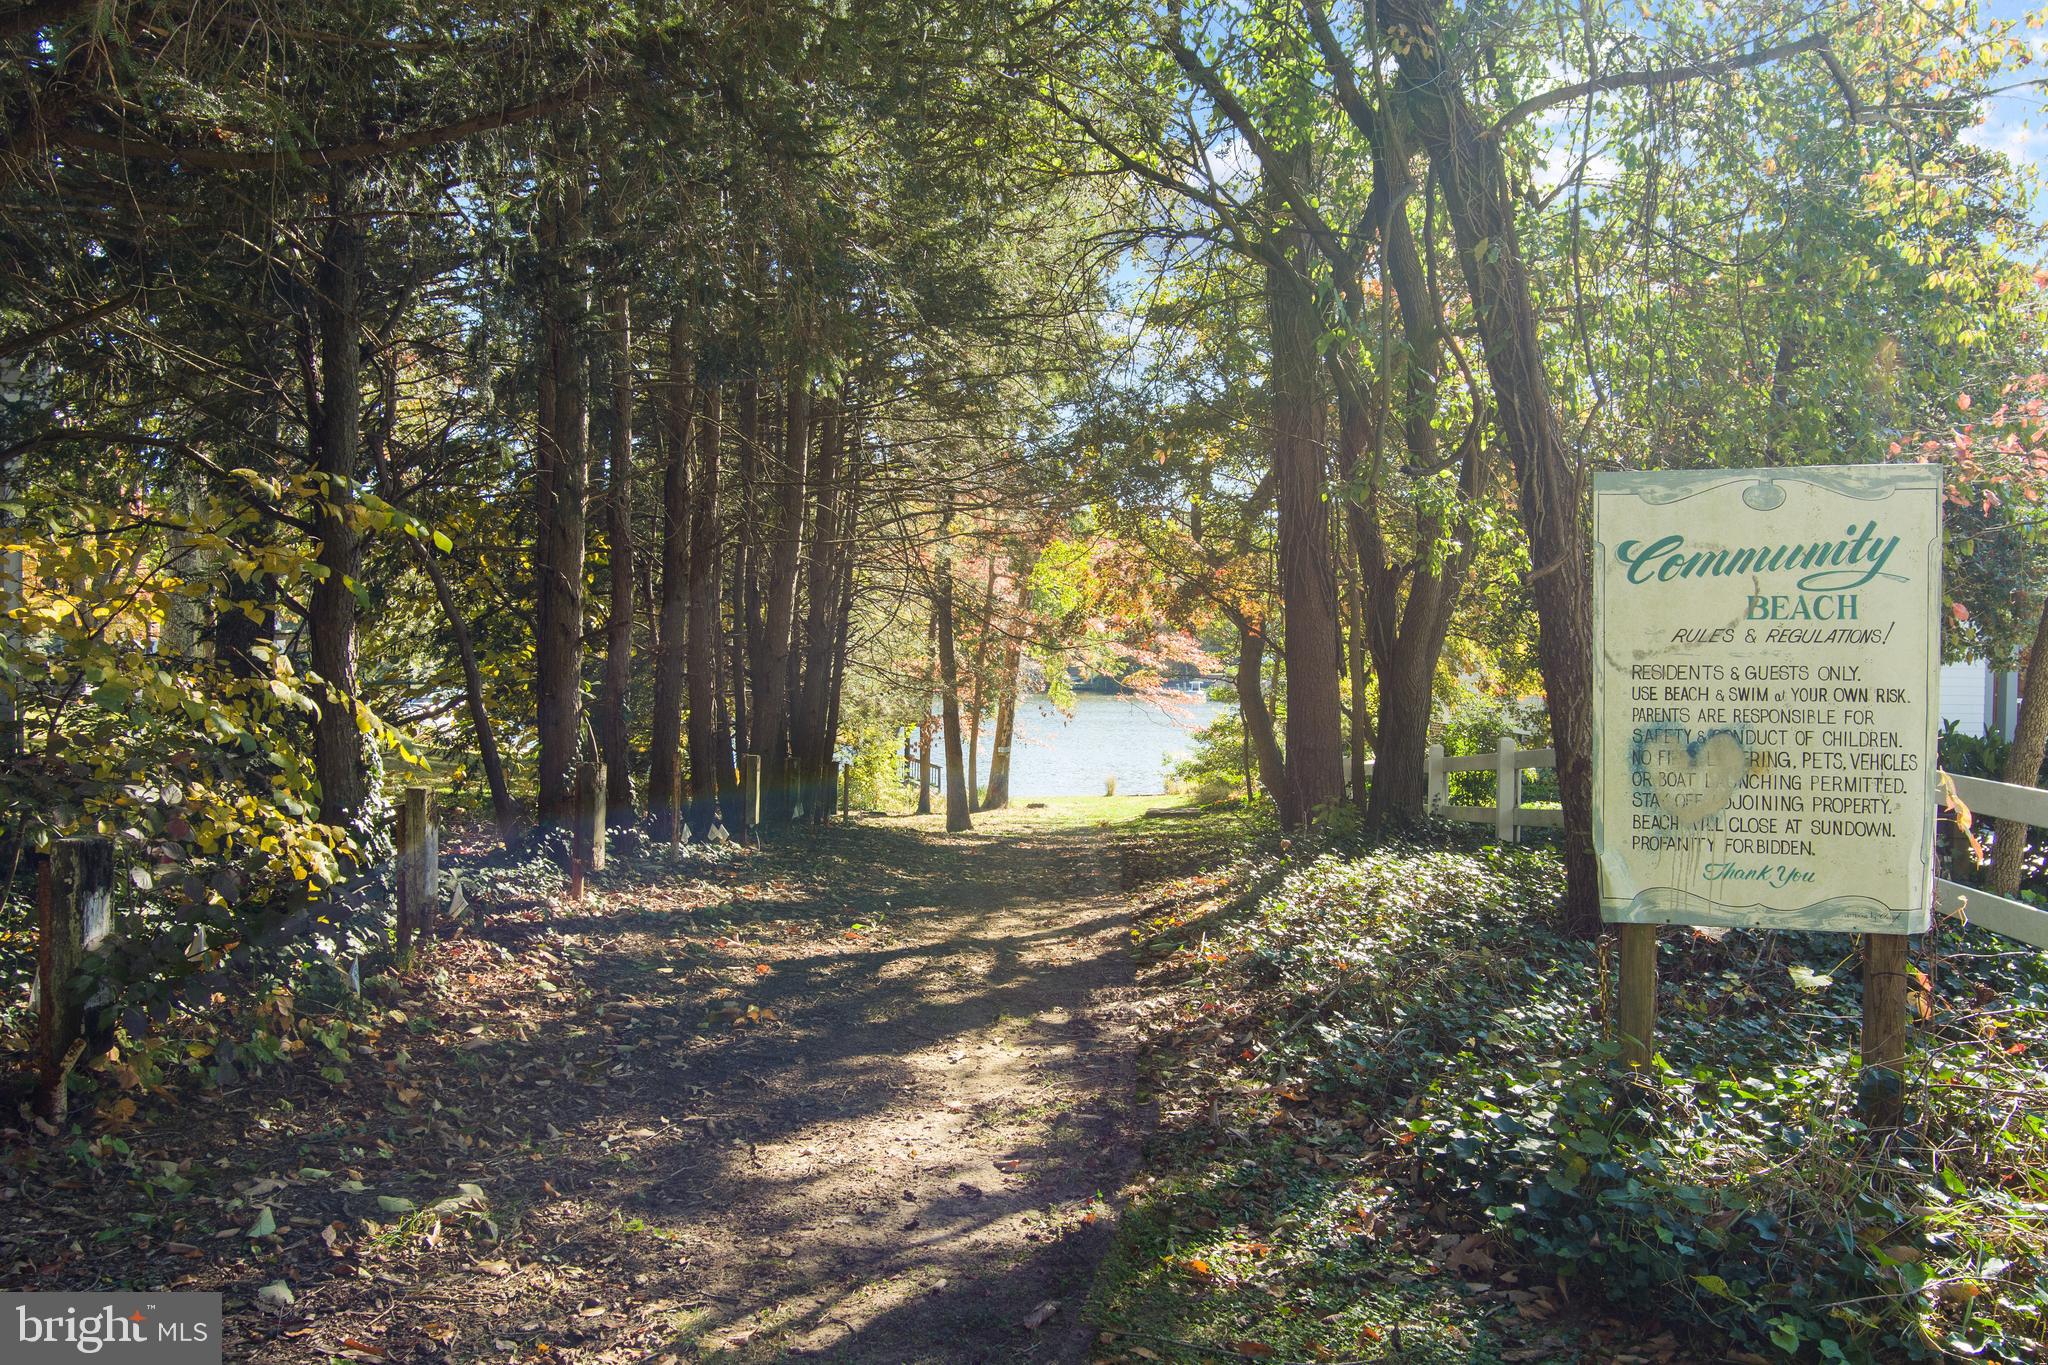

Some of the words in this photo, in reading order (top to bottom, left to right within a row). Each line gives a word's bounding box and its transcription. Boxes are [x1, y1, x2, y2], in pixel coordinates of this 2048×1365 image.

[1616, 520, 1911, 592] Community
[1747, 595, 1858, 620] BEACH
[1671, 628, 1735, 643] RULES
[1745, 628, 1757, 643] &
[1766, 621, 1895, 645] REGULATIONS!
[1632, 665, 1724, 681] RESIDENTS
[1730, 667, 1740, 681] &
[1745, 665, 1809, 681] GUESTS
[1818, 666, 1861, 682] ONLY.
[1632, 687, 1658, 701] USE
[1664, 687, 1709, 701] BEACH
[1715, 690, 1725, 702] &
[1728, 687, 1769, 702] SWIM
[1791, 687, 1828, 702] YOUR
[1833, 688, 1868, 703] OWN
[1876, 688, 1911, 704] RISK.
[1632, 708, 1691, 723] PARENTS
[1697, 708, 1727, 723] ARE
[1733, 708, 1836, 725] RESPONSIBLE
[1844, 710, 1875, 725] FOR
[1632, 728, 1692, 744] SAFETY
[1708, 729, 1788, 746] NDUCT
[1795, 731, 1815, 746] OF
[1822, 731, 1903, 748] CHILDREN.
[1632, 749, 1652, 766] NO
[1850, 752, 1918, 771] VEHICLES
[1632, 771, 1652, 787] OR
[1659, 772, 1696, 788] BOAT
[1705, 773, 1802, 791] LNCHING
[1811, 775, 1907, 794] PERMITTED.
[1632, 791, 1669, 808] STA
[1812, 796, 1892, 815] PROPERTY.
[1632, 814, 1679, 830] BEACH
[1728, 816, 1777, 834] CLOSE
[1785, 818, 1803, 834] AT
[1810, 819, 1896, 838] SUNDOWN.
[1725, 838, 1816, 857] FORBIDDEN.
[1702, 862, 1774, 881] Thank
[1769, 865, 1816, 889] You
